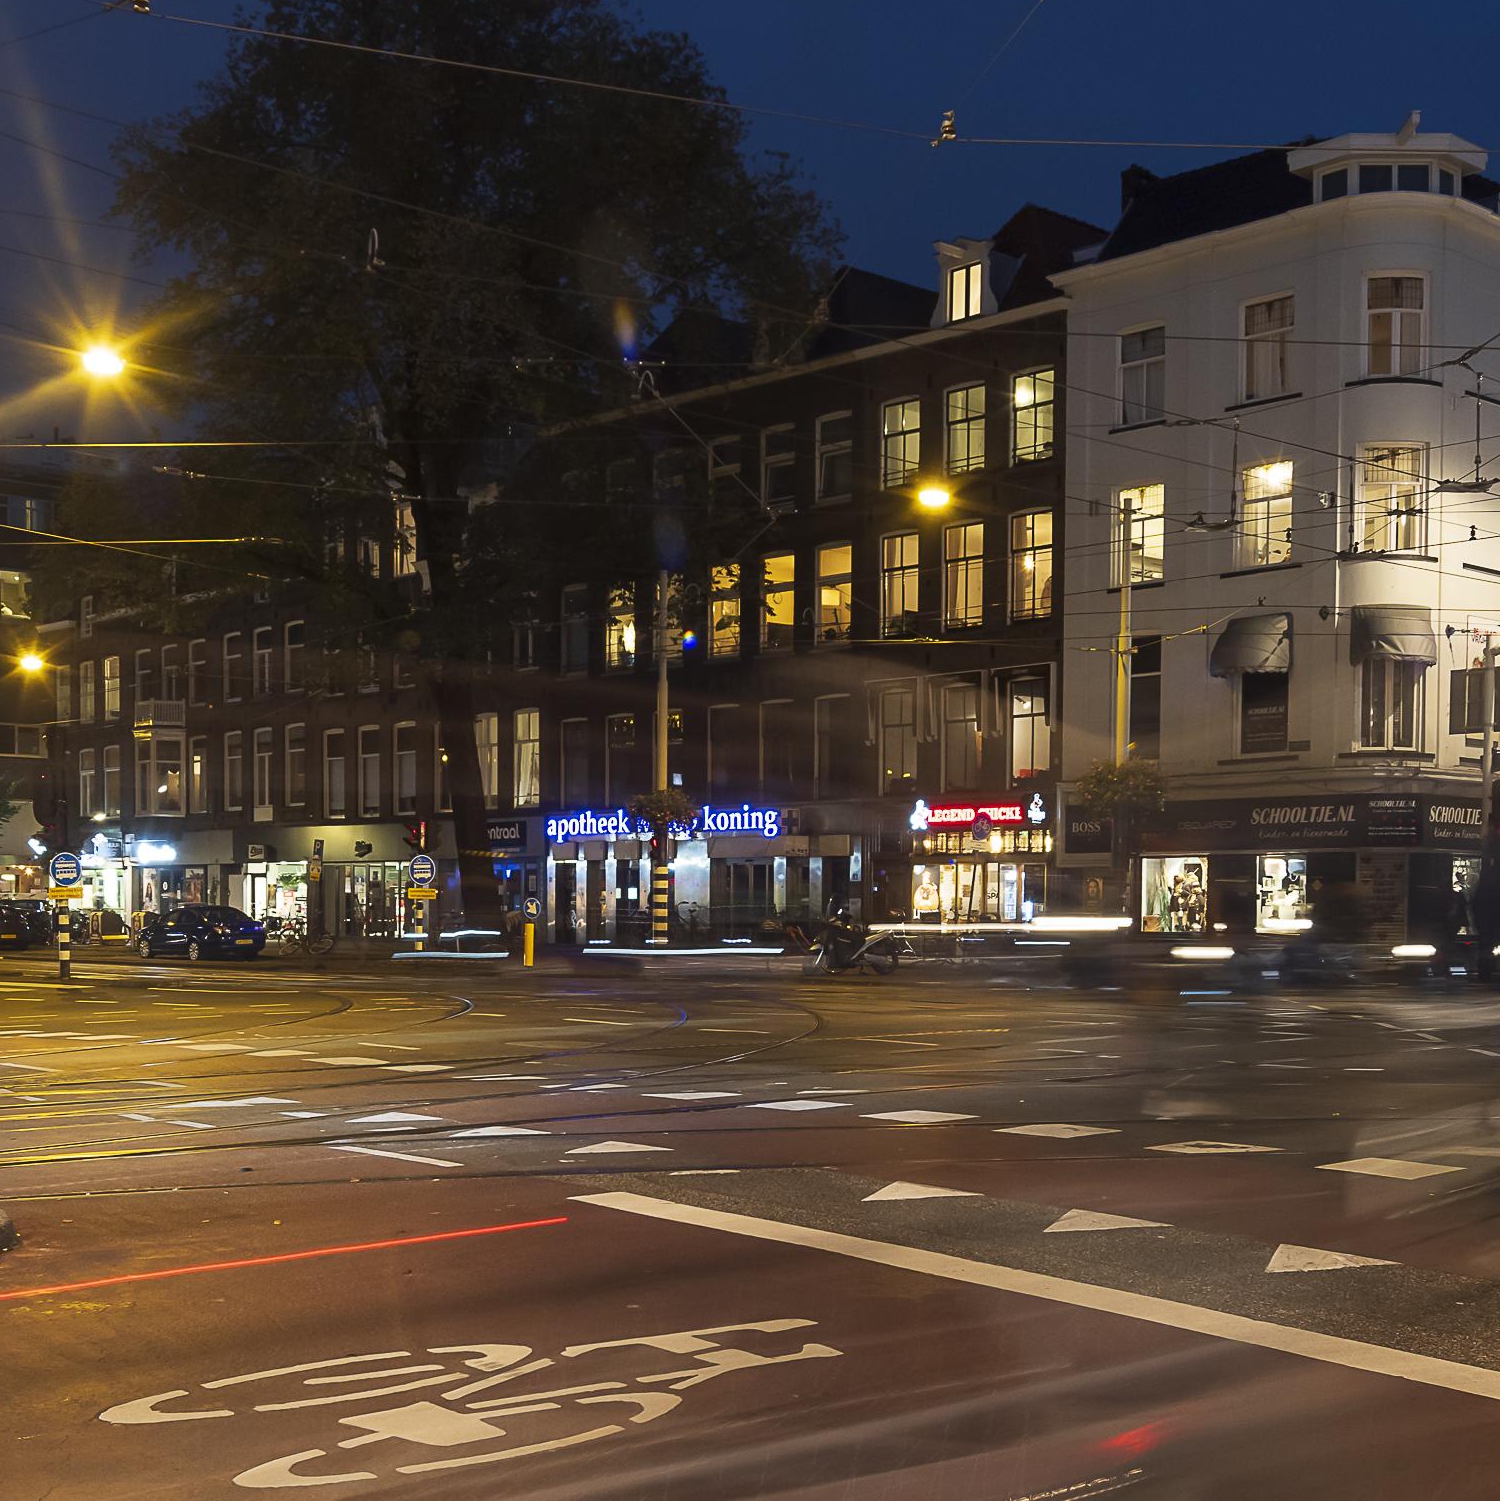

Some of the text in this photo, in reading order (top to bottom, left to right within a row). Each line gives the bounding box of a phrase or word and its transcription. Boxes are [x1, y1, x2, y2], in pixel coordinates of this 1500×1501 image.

[928, 808, 975, 823] LEGEND
[1250, 804, 1356, 826] SCHOOLTJE.NL
[488, 822, 520, 840] ntraal
[547, 808, 630, 843] apotheek
[703, 804, 779, 838] koning
[1072, 820, 1101, 833] BOSS
[315, 841, 321, 855] P
